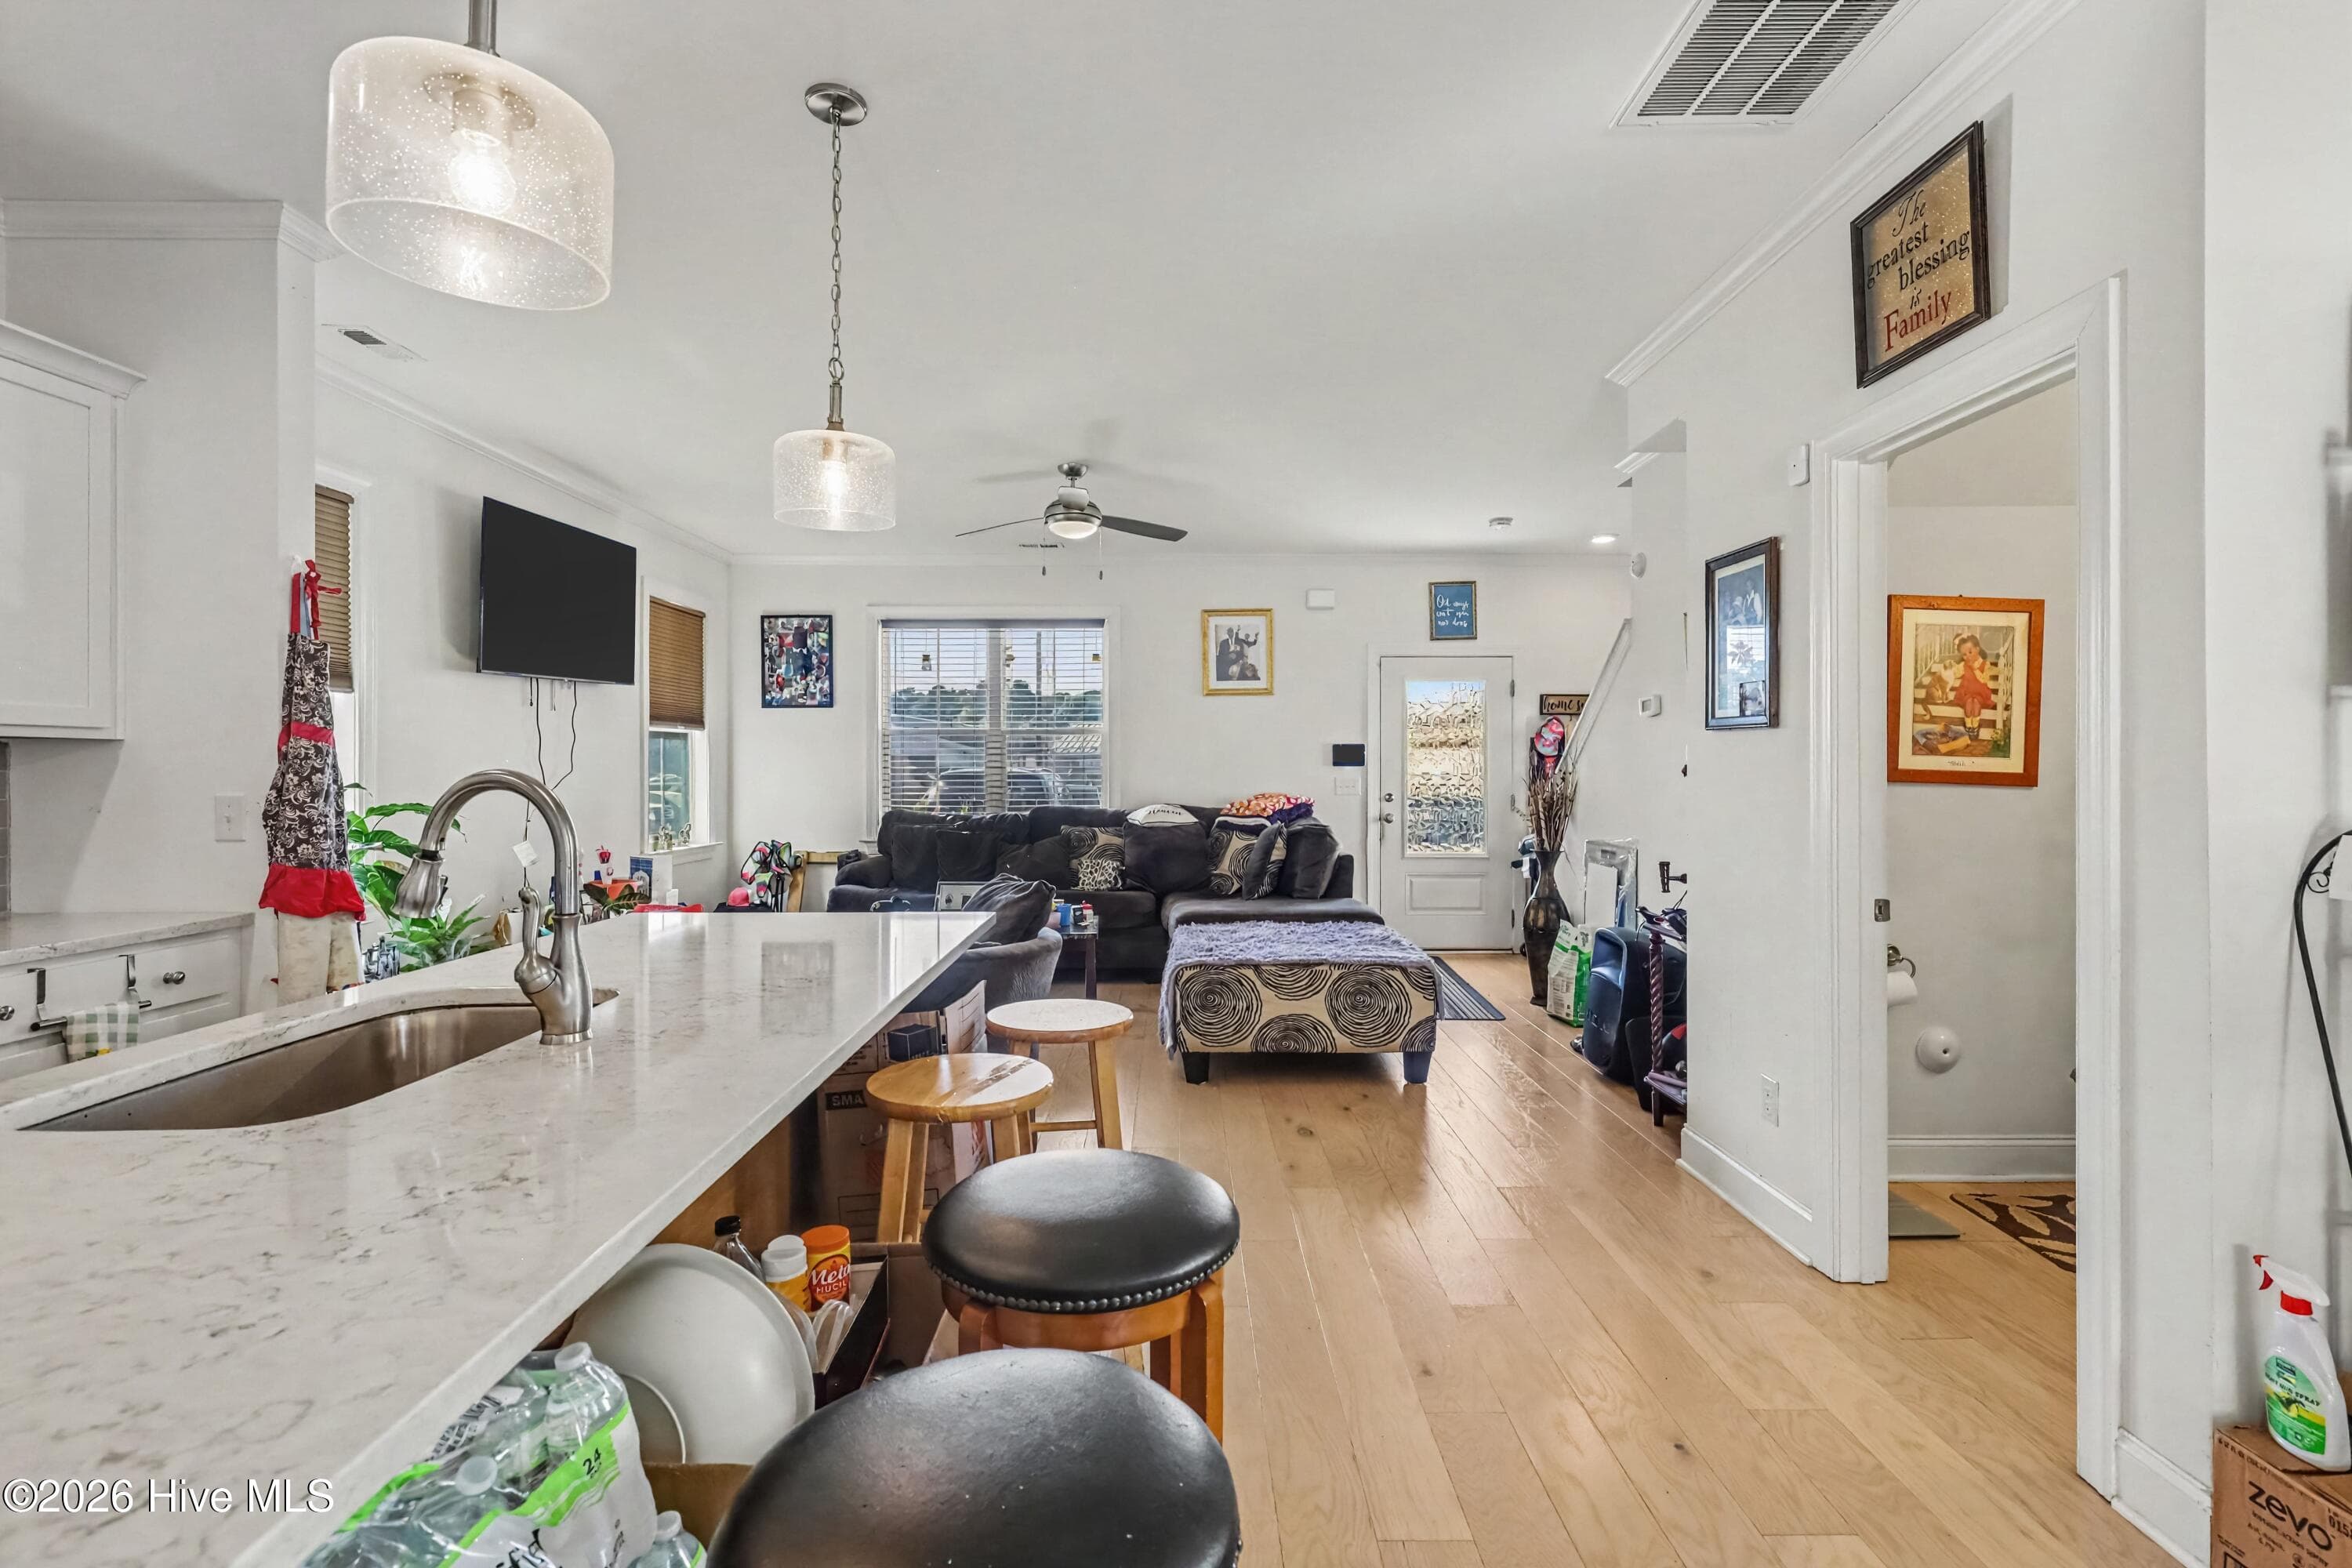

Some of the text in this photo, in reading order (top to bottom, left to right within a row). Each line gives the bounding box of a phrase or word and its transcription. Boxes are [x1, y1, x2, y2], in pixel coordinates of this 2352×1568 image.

[1892, 189, 1926, 237] The
[1867, 220, 1929, 289] greatest
[1898, 230, 1971, 292] blessing
[1883, 289, 1952, 352] Family
[1910, 285, 1922, 310] is
[832, 1094, 864, 1107] SMA
[583, 1446, 601, 1475] 24
[2248, 1480, 2333, 1552] zevo
